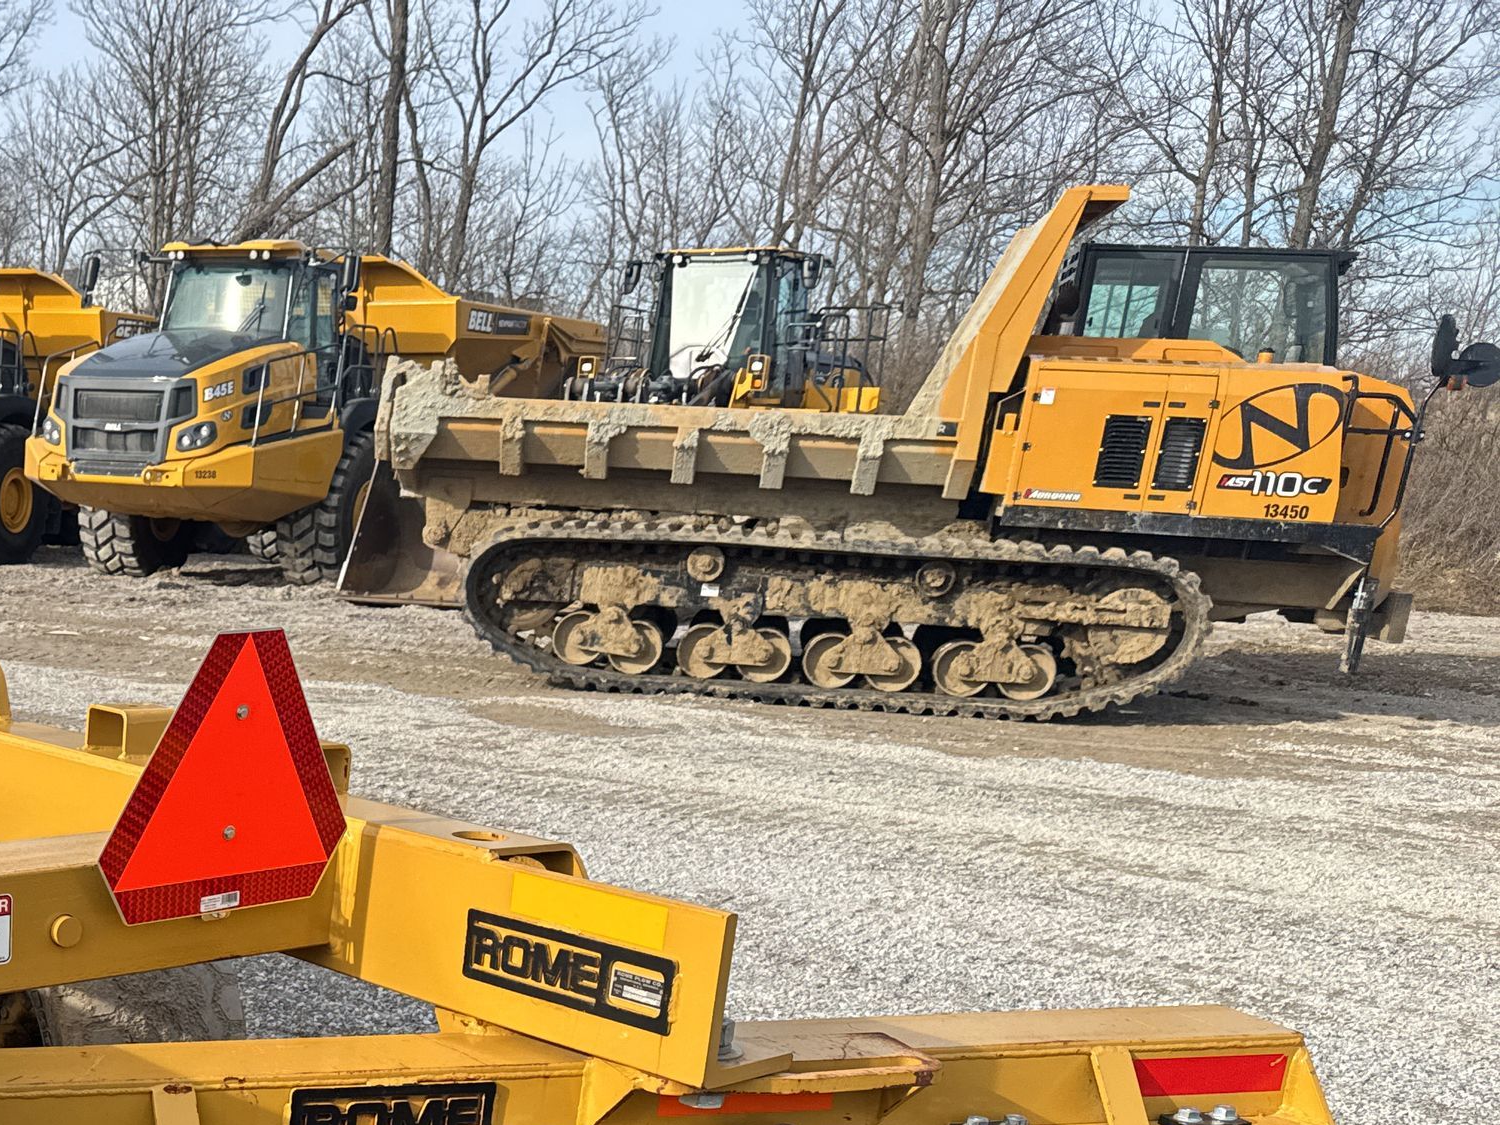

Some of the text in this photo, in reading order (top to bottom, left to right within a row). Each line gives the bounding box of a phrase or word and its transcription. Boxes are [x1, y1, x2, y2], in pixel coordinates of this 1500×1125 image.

[468, 310, 493, 332] BELL
[203, 380, 234, 402] B45E
[1263, 503, 1310, 519] 13450
[470, 926, 601, 994] ROME
